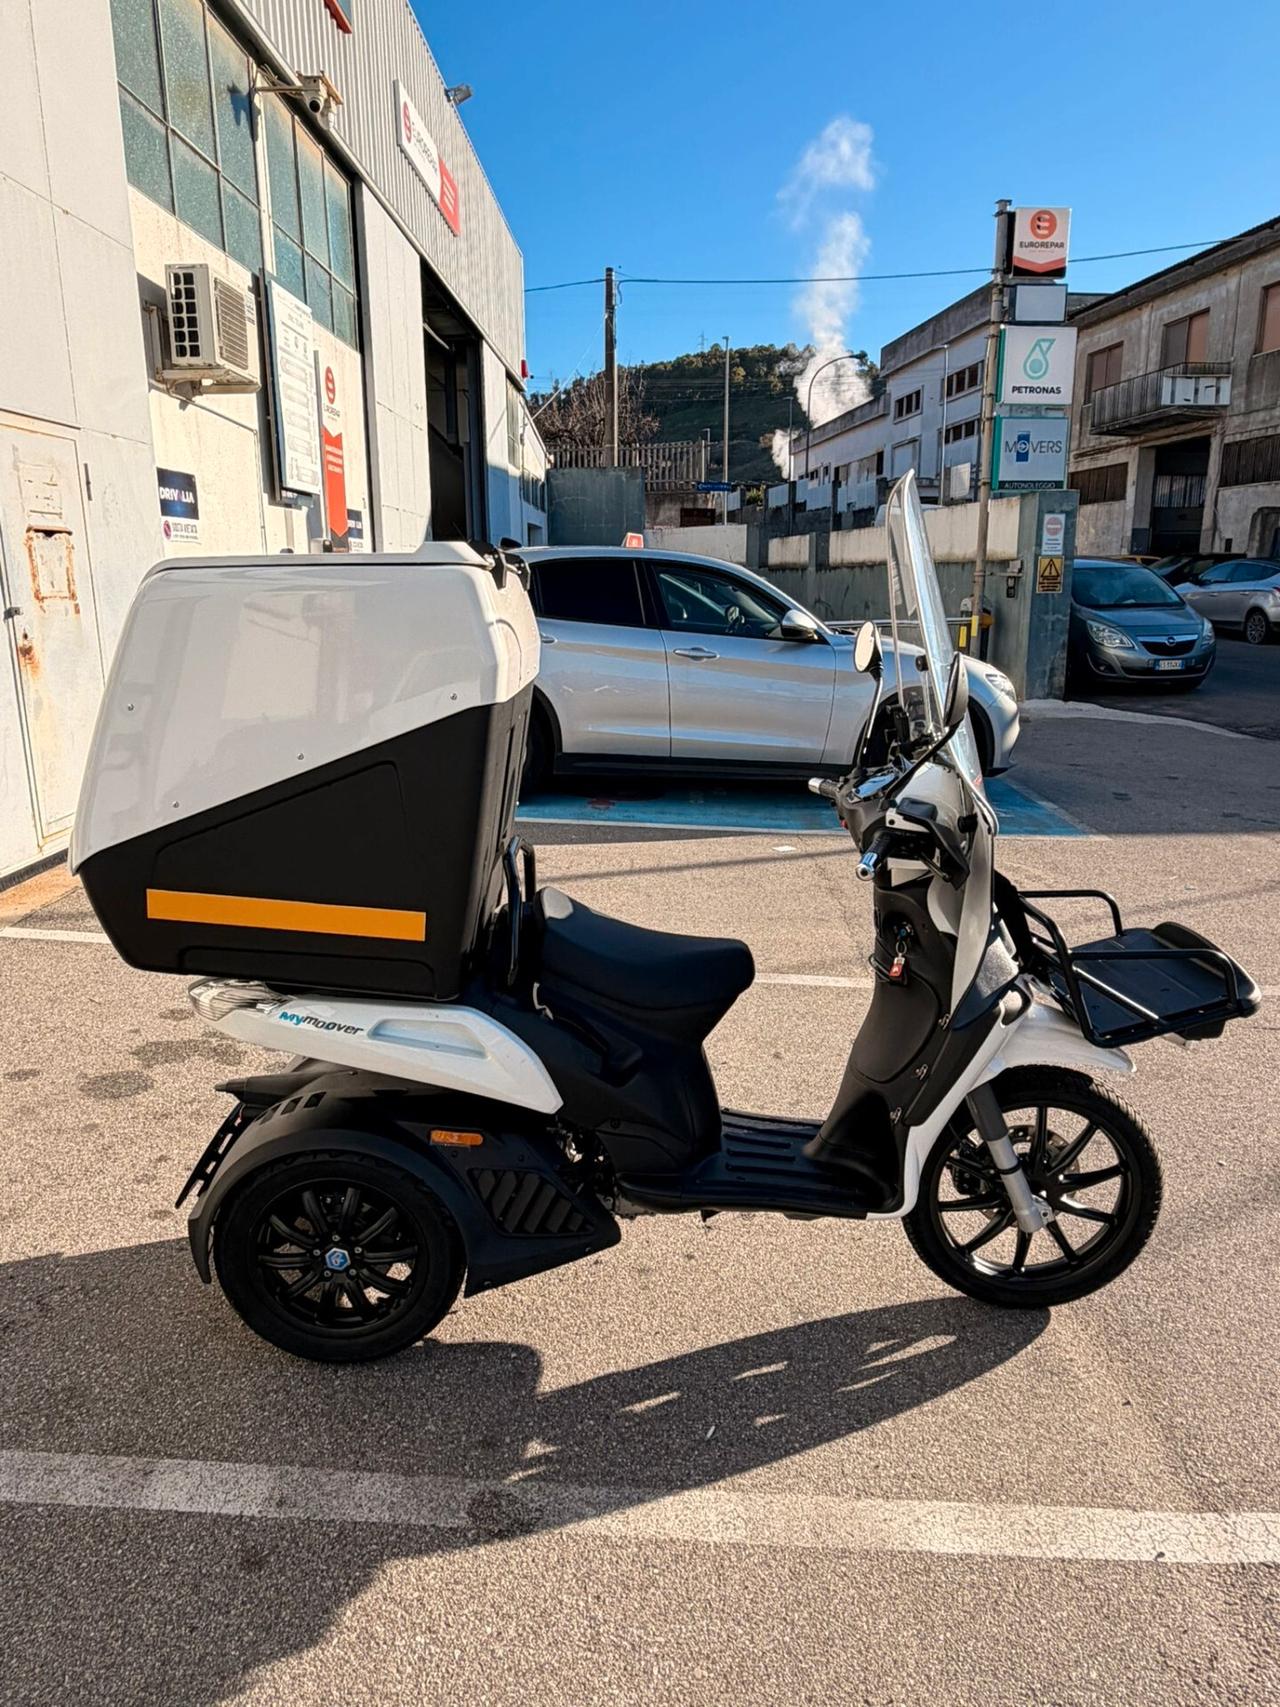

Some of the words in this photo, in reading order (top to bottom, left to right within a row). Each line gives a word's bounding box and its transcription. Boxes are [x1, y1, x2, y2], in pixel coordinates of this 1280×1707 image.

[1019, 241, 1065, 249] EUROREPAR
[1011, 385, 1062, 395] PETRONAS
[1004, 439, 1063, 454] MOVERS
